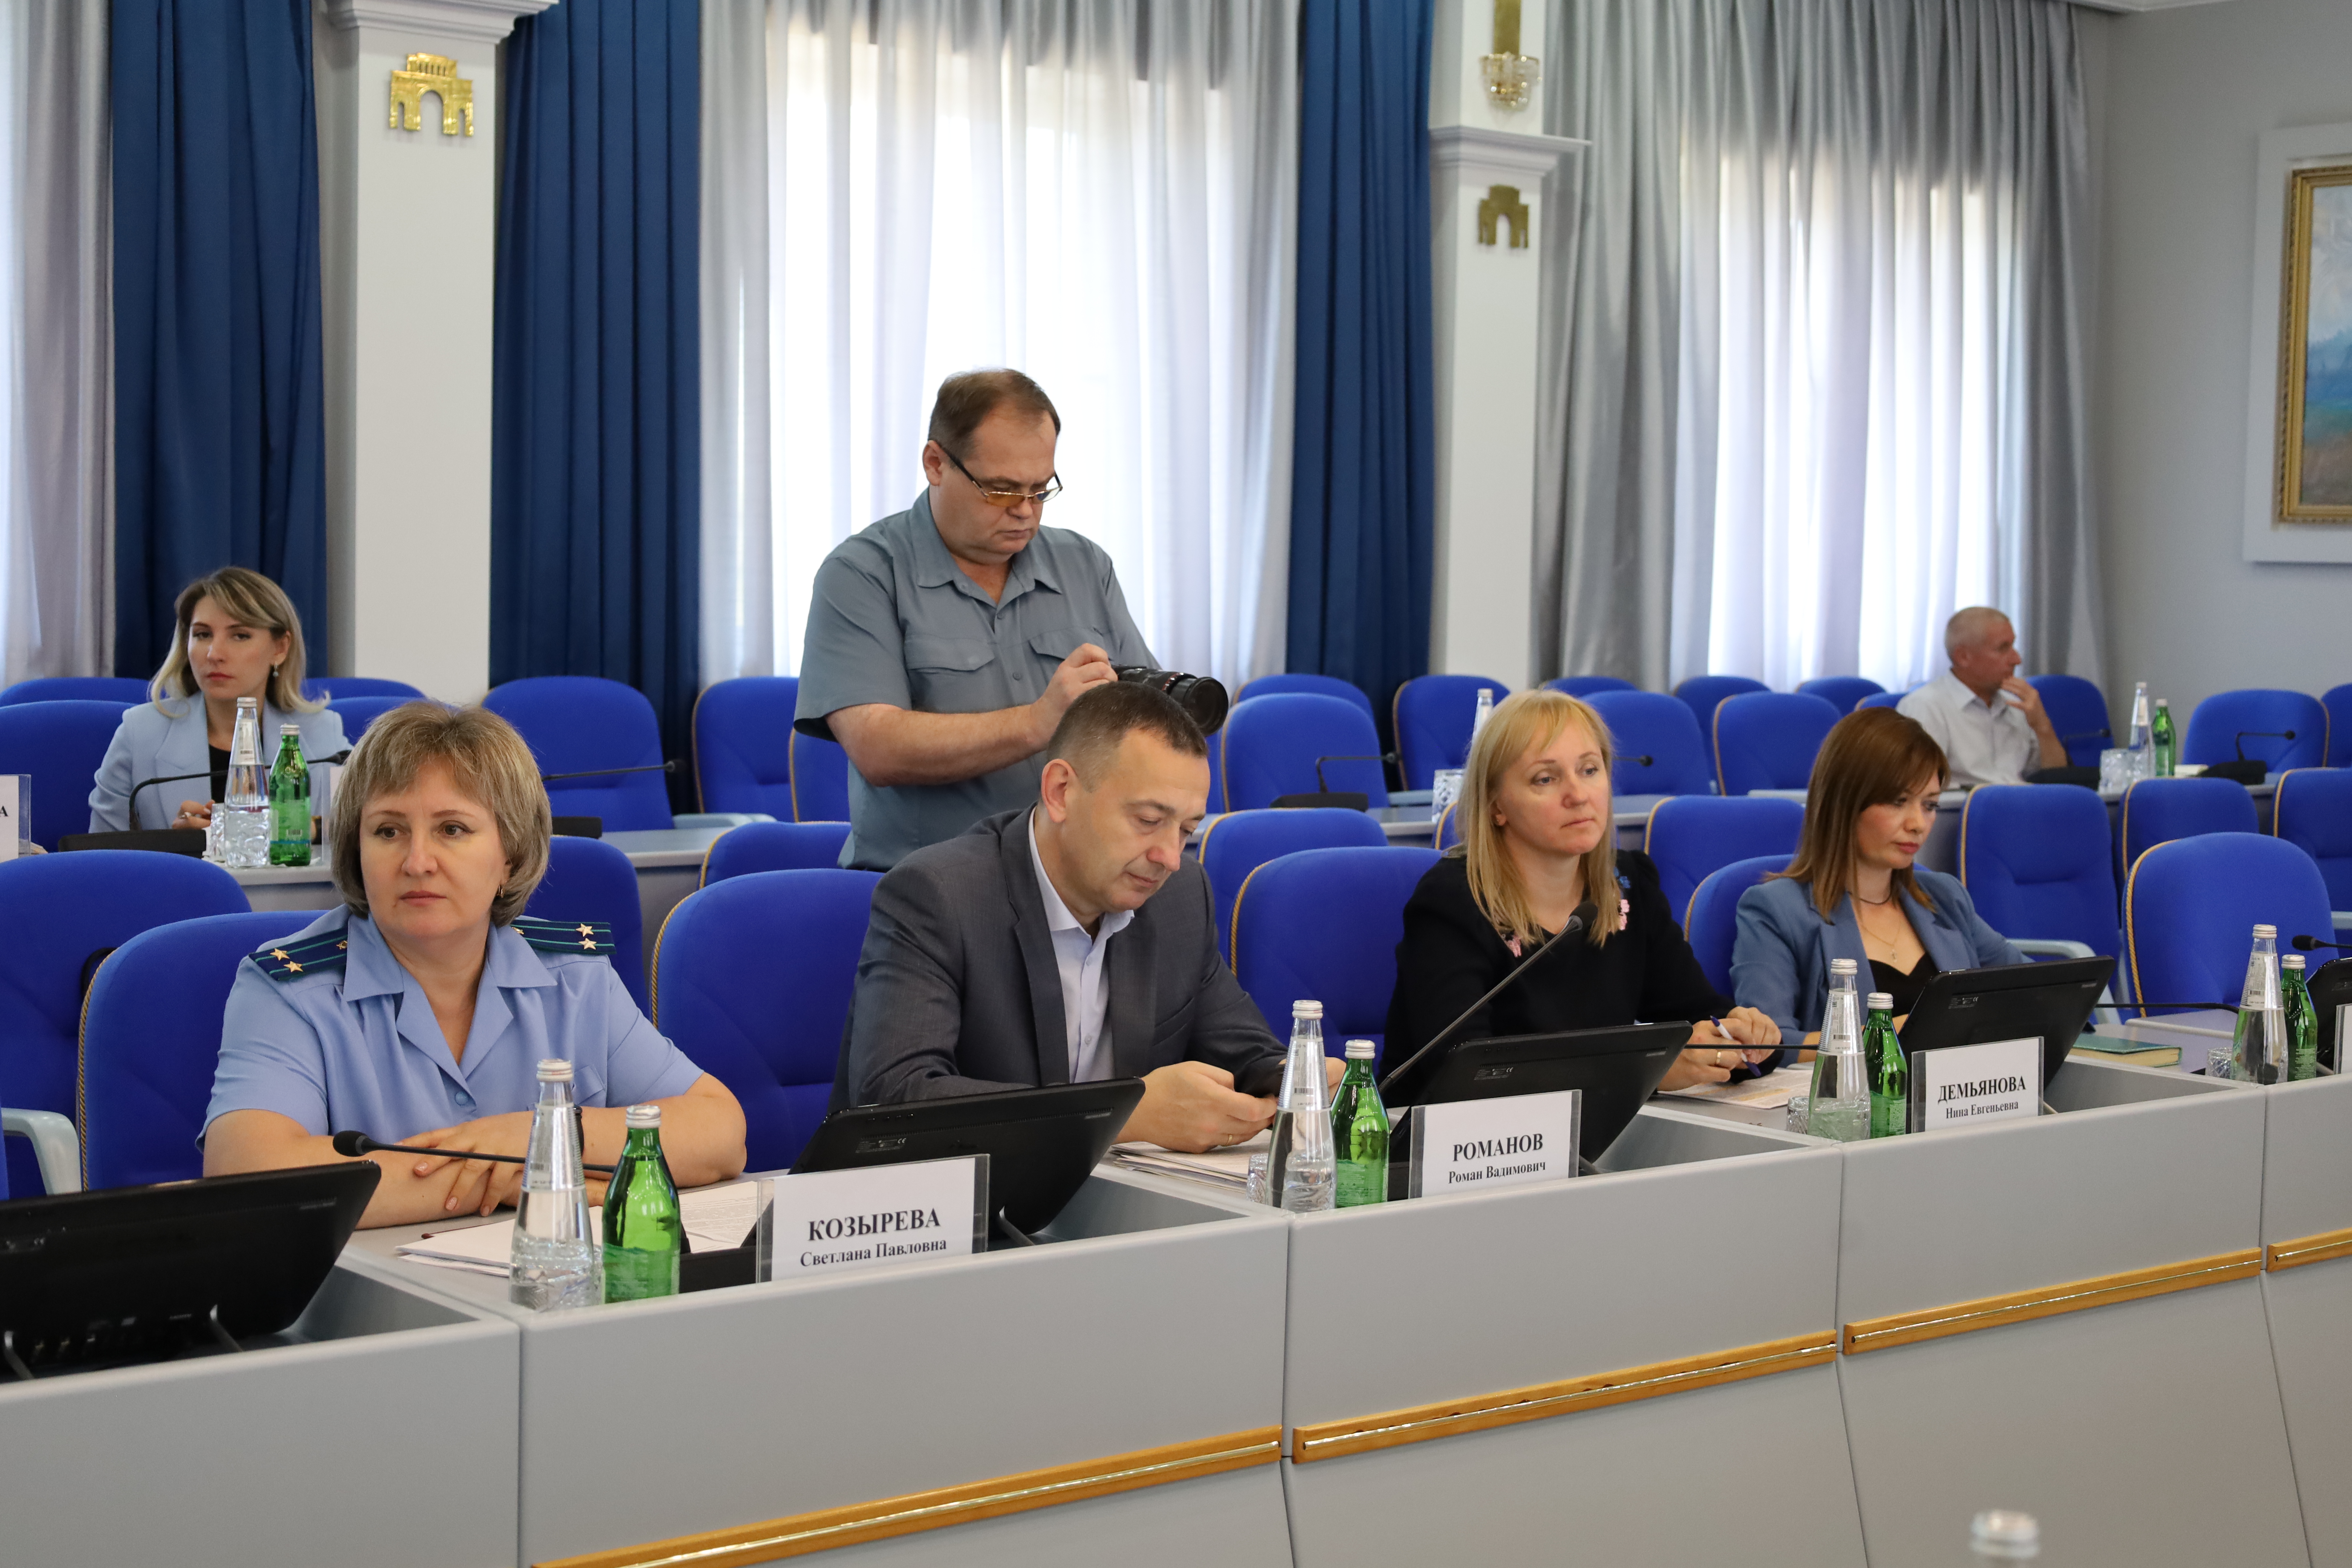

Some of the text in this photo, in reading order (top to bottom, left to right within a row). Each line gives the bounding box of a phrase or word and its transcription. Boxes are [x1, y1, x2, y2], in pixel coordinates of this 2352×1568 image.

[1937, 1075, 2026, 1104] ДЕМЬЯНОВА
[1946, 1101, 2019, 1119] Нина Евгеньевна
[1453, 1133, 1543, 1162] РОМАНОВ
[1448, 1162, 1546, 1184] Роман Вадимович
[808, 1207, 941, 1241] КОЗЫРЕВА
[800, 1239, 947, 1266] Светлана Павловна
